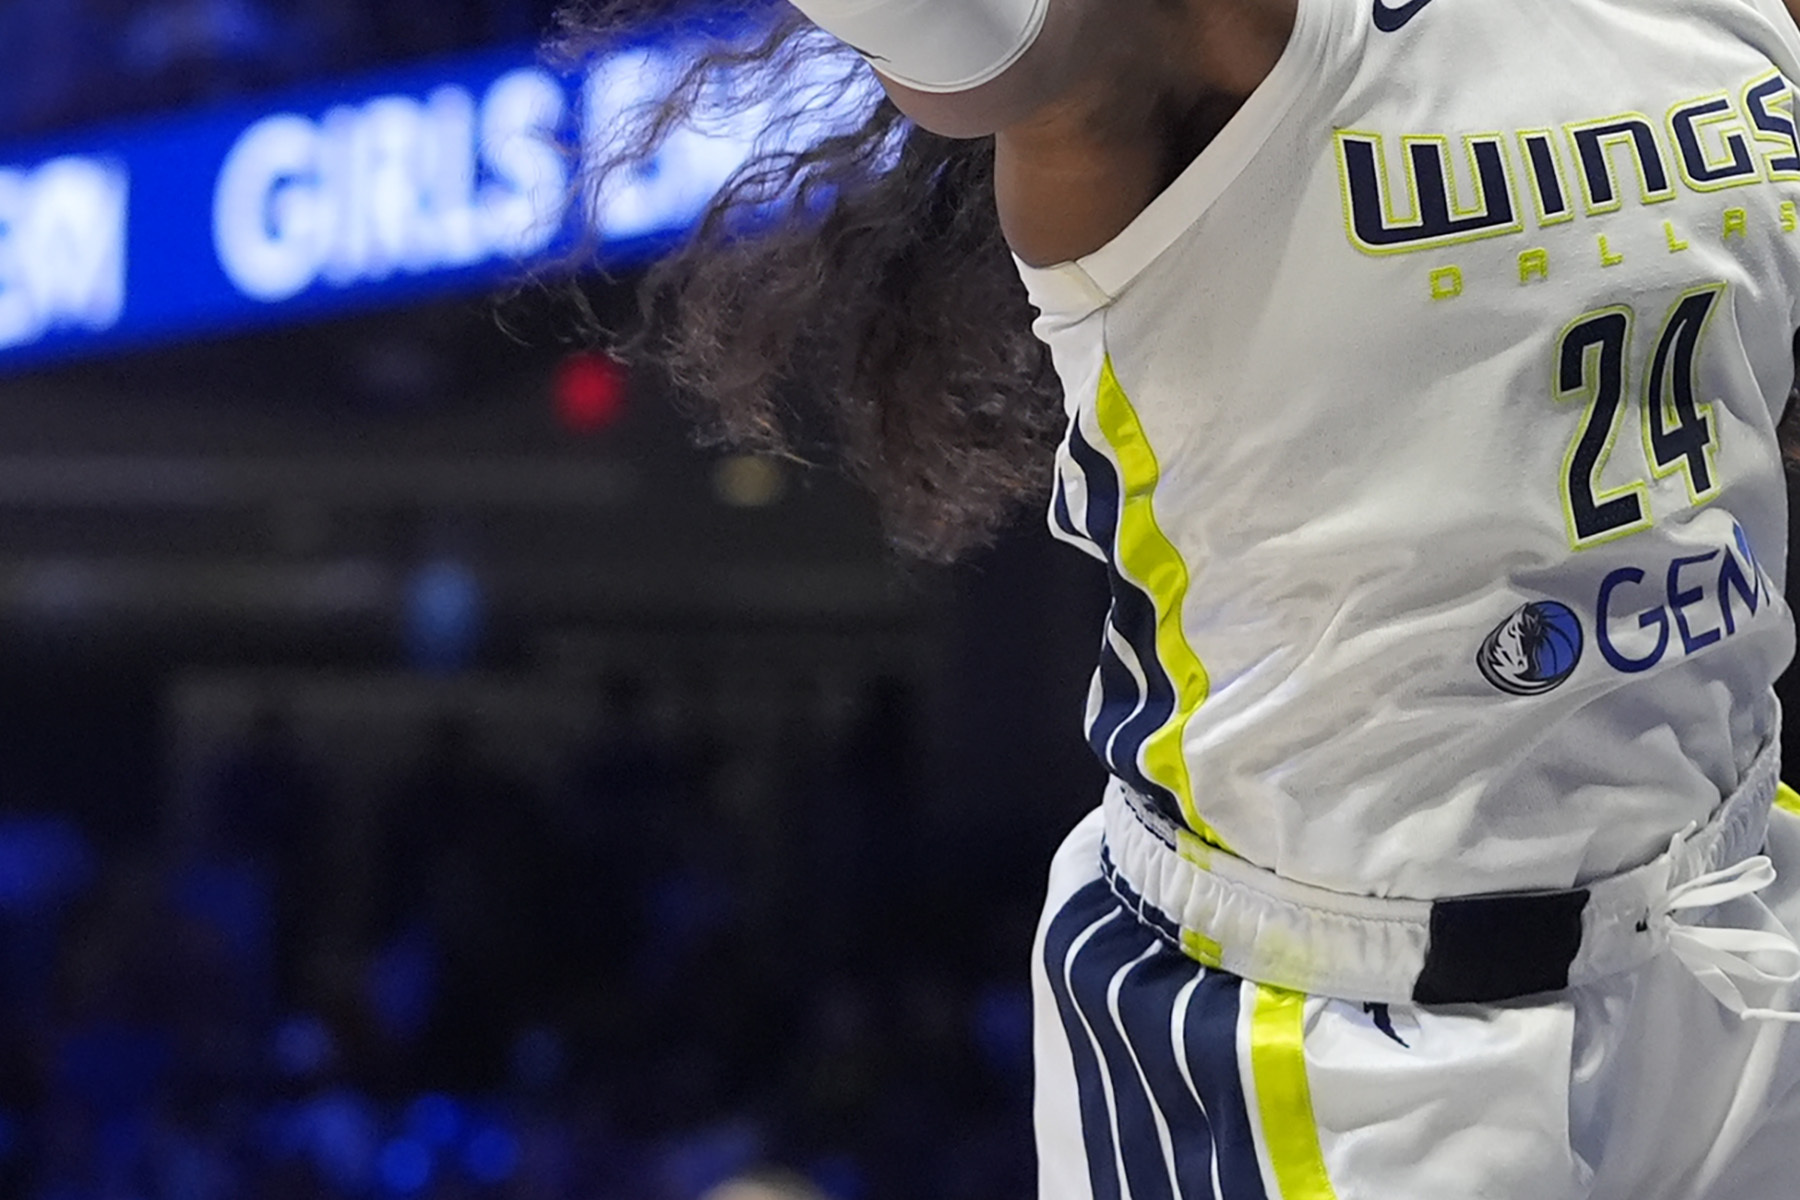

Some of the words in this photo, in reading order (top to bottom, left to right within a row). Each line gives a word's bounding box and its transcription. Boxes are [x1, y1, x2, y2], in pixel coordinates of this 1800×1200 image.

[212, 65, 572, 302] GIRLS
[1429, 202, 1797, 302] DALLAS
[1553, 281, 1727, 552] 24
